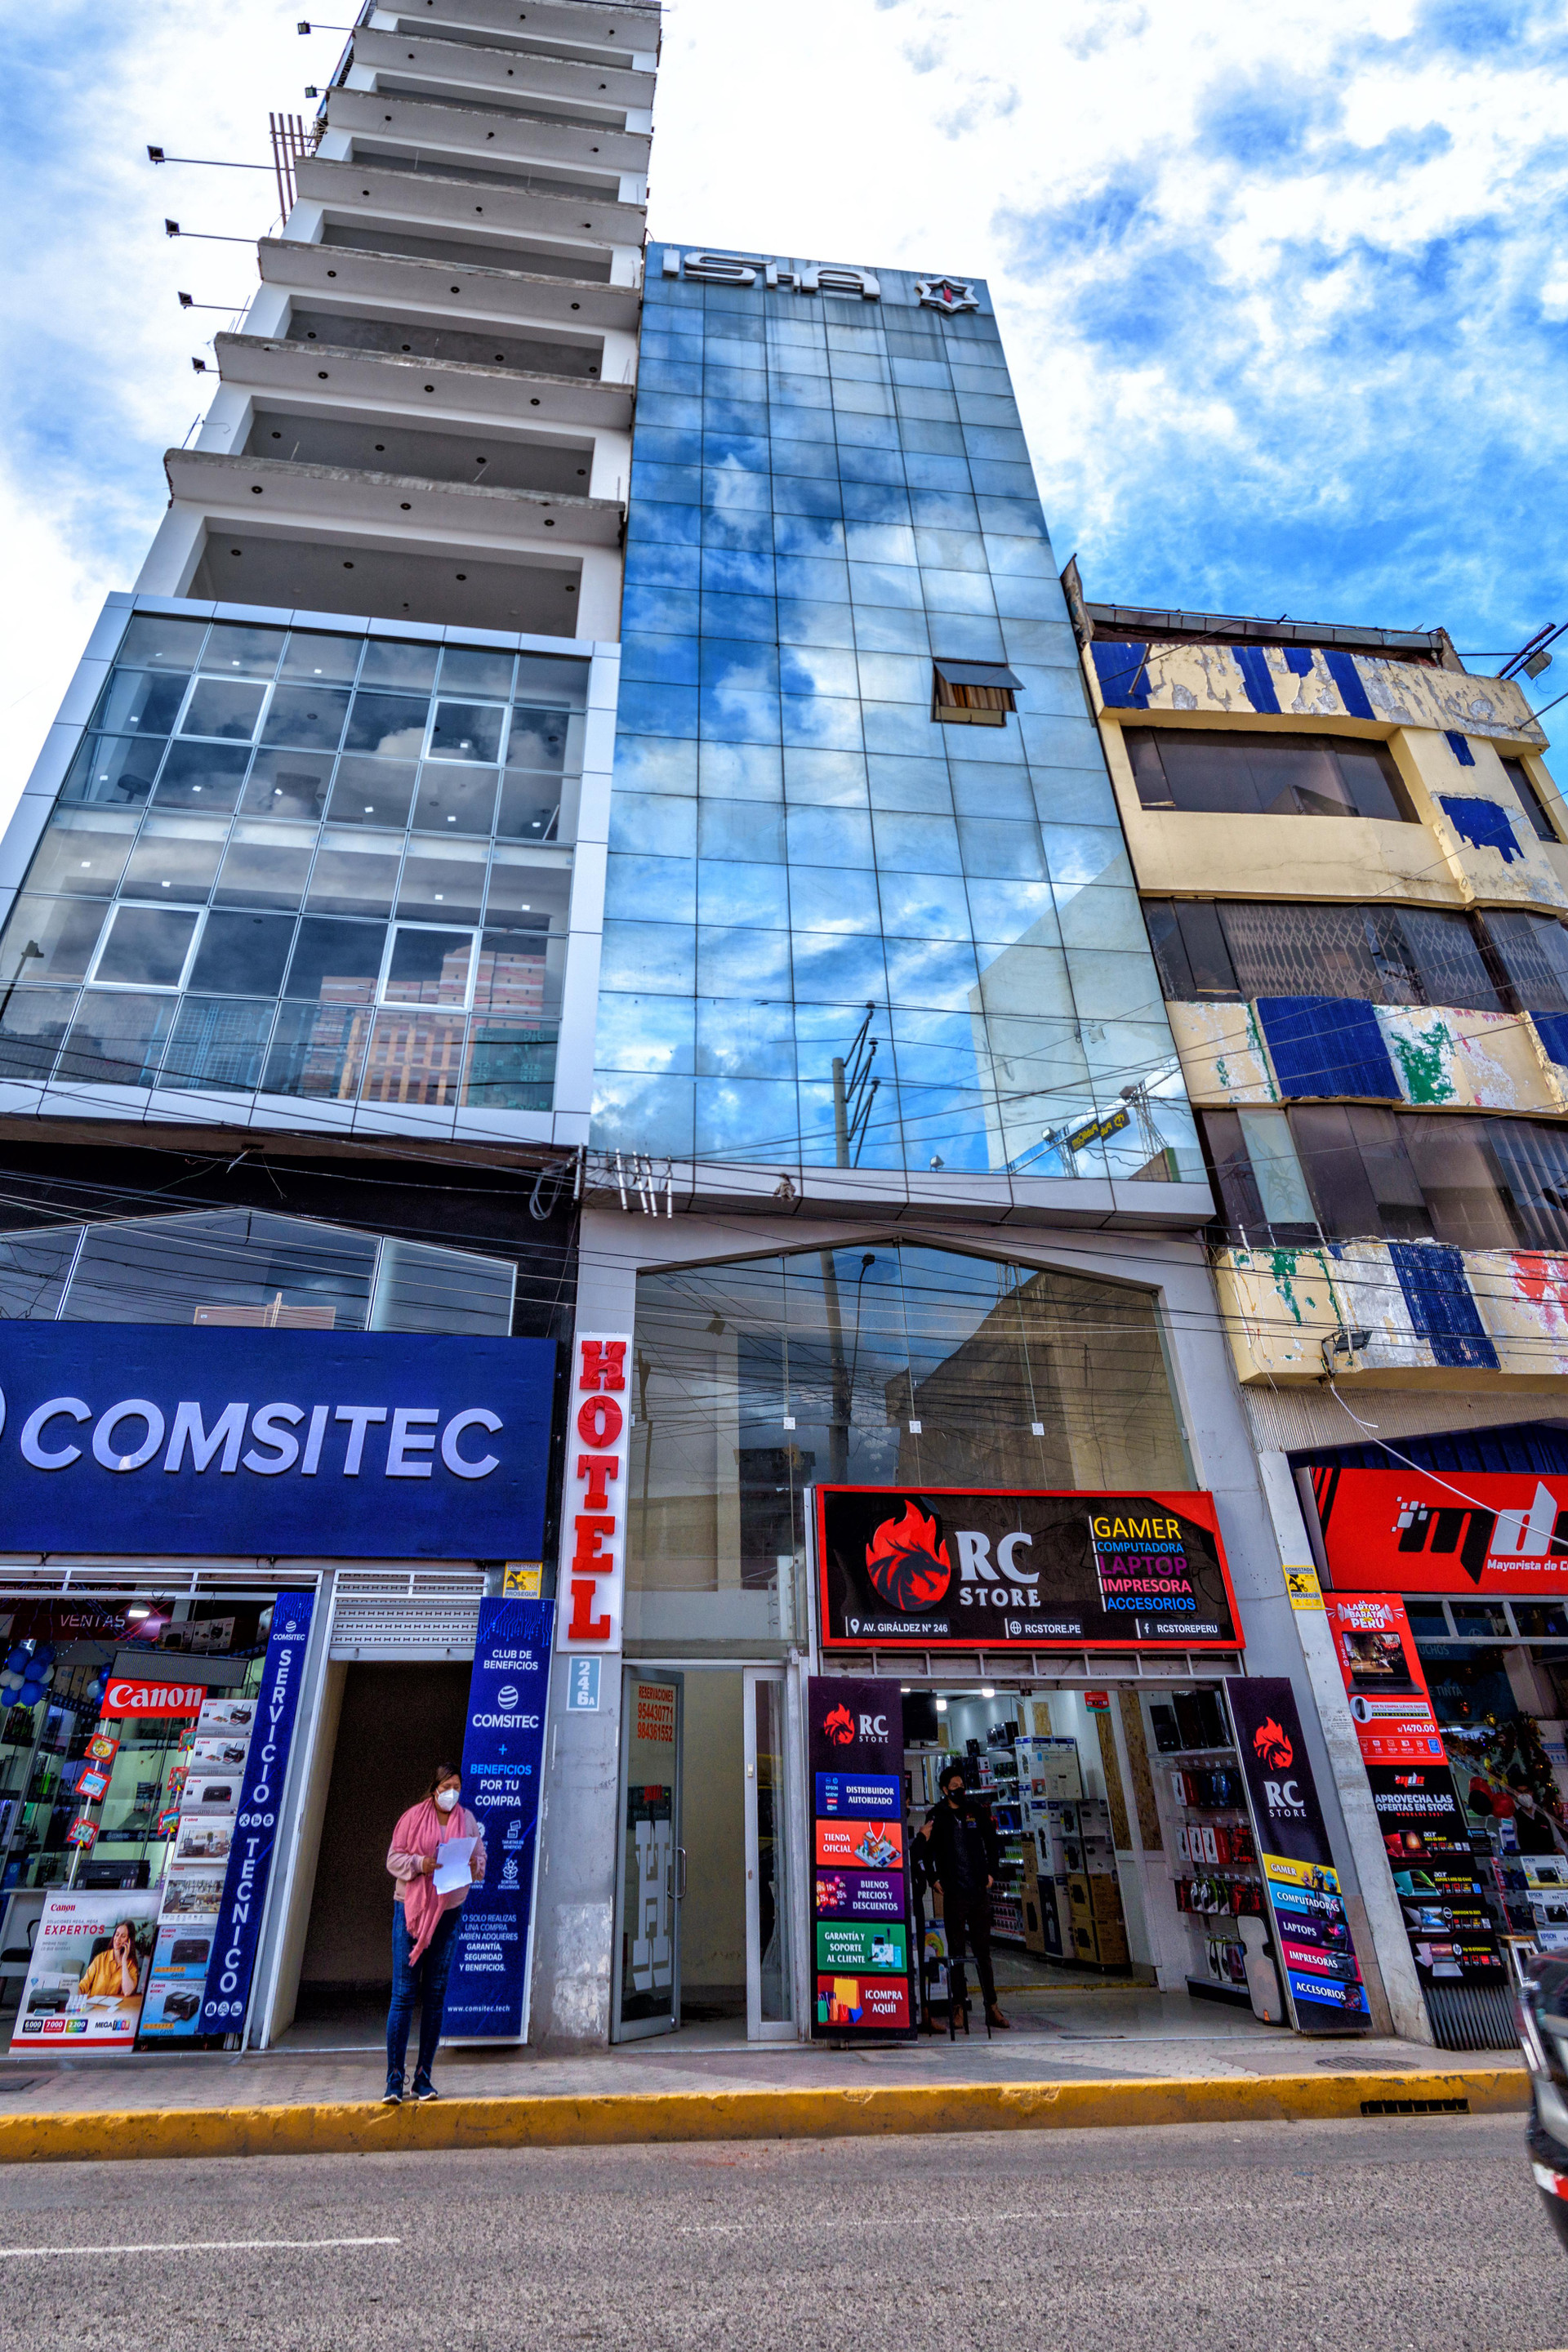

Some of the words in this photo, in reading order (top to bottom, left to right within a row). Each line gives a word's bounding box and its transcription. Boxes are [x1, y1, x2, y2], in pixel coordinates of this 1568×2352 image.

[20, 1397, 503, 1479] COMSITEC
[568, 1340, 626, 1639] HOTEL
[1093, 1517, 1182, 1540] GAMER
[1097, 1541, 1184, 1553] COMPUTADORA
[955, 1530, 1040, 1584] RC
[1099, 1555, 1188, 1576] LAPTOP
[1486, 1559, 1541, 1572] Mayorista
[1544, 1560, 1557, 1570] de
[1560, 1561, 1568, 1570] C
[1102, 1579, 1193, 1593] IMPRESORA
[959, 1588, 1041, 1608] STORE
[1107, 1597, 1196, 1611] ACCESORIOS
[1347, 1603, 1381, 1611] LAPTOP
[60, 1615, 126, 1628] VENTAS
[862, 1623, 875, 1633] AV.
[877, 1620, 922, 1633] GIRÁLDEZ
[933, 1623, 948, 1633] 246
[1024, 1623, 1082, 1634] RCSTORE.PE
[1156, 1623, 1218, 1634] RCSTOREPERU
[492, 1649, 517, 1659] CLUB
[519, 1650, 532, 1659] DE
[483, 1660, 538, 1670] BENEFICIOS
[109, 1684, 203, 1708] Canon
[639, 1685, 674, 1703] RESERVACIONES
[638, 1702, 674, 1723] 954430771
[472, 1713, 539, 1728] COMSITEC
[859, 1715, 889, 1736] RC
[252, 1649, 292, 1804] SERVICIO
[637, 1722, 673, 1742] 984361552
[1402, 1724, 1436, 1733] 1470.00
[470, 1764, 532, 1775] BENEFICIOS
[480, 1780, 502, 1790] POR
[504, 1780, 519, 1790] TU
[846, 1785, 894, 1795] DISTRIBUIDOR
[1263, 1780, 1304, 1807] RC
[1375, 1793, 1433, 1803] APROVECHA
[1433, 1793, 1453, 1803] LAS
[474, 1796, 521, 1806] COMPRA
[848, 1796, 893, 1805] AUTORIZADO
[1376, 1803, 1414, 1811] OFERTAS
[1414, 1803, 1427, 1811] EN
[1428, 1803, 1455, 1811] STOCK
[1269, 1809, 1307, 1818] STORE
[824, 1833, 851, 1842] TIENDA
[822, 1843, 852, 1853] OFICIAL
[1271, 1863, 1297, 1876] GAMER
[860, 1880, 889, 1889] BUENOS
[836, 1891, 847, 1899] 35%
[858, 1891, 887, 1900] PRECIOS
[888, 1891, 893, 1900] Y
[853, 1901, 898, 1911] DESCUENTOS
[1276, 1891, 1340, 1913] COMPUTADORAS
[51, 1904, 76, 1913] Canon
[220, 1838, 261, 1993] TECNICO
[469, 1914, 487, 1922] SOLO
[488, 1914, 517, 1922] REALIZAS
[44, 1924, 105, 1936] EXPERTOS
[1283, 1922, 1317, 1936] LAPTOPS
[482, 1932, 519, 1941] ADQUIERES
[824, 1930, 860, 1940] GARANTÍA
[860, 1932, 865, 1940] Y
[466, 1941, 502, 1951] GARANTÍA,
[829, 1943, 862, 1953] SOPORTE
[464, 1953, 503, 1961] SEGURIDAD
[826, 1954, 836, 1963] AL
[837, 1954, 866, 1964] CLIENTE
[1289, 1950, 1338, 1969] IMPRESORAS
[459, 1963, 465, 1971] Y
[466, 1963, 506, 1972] BENEFICIOS.
[865, 1989, 903, 2000] ¡COMPRA
[1296, 1982, 1347, 2001] ACCESORIOS
[448, 2004, 510, 2012] www.comsitec.tech
[872, 2001, 897, 2015] AQUÍ!
